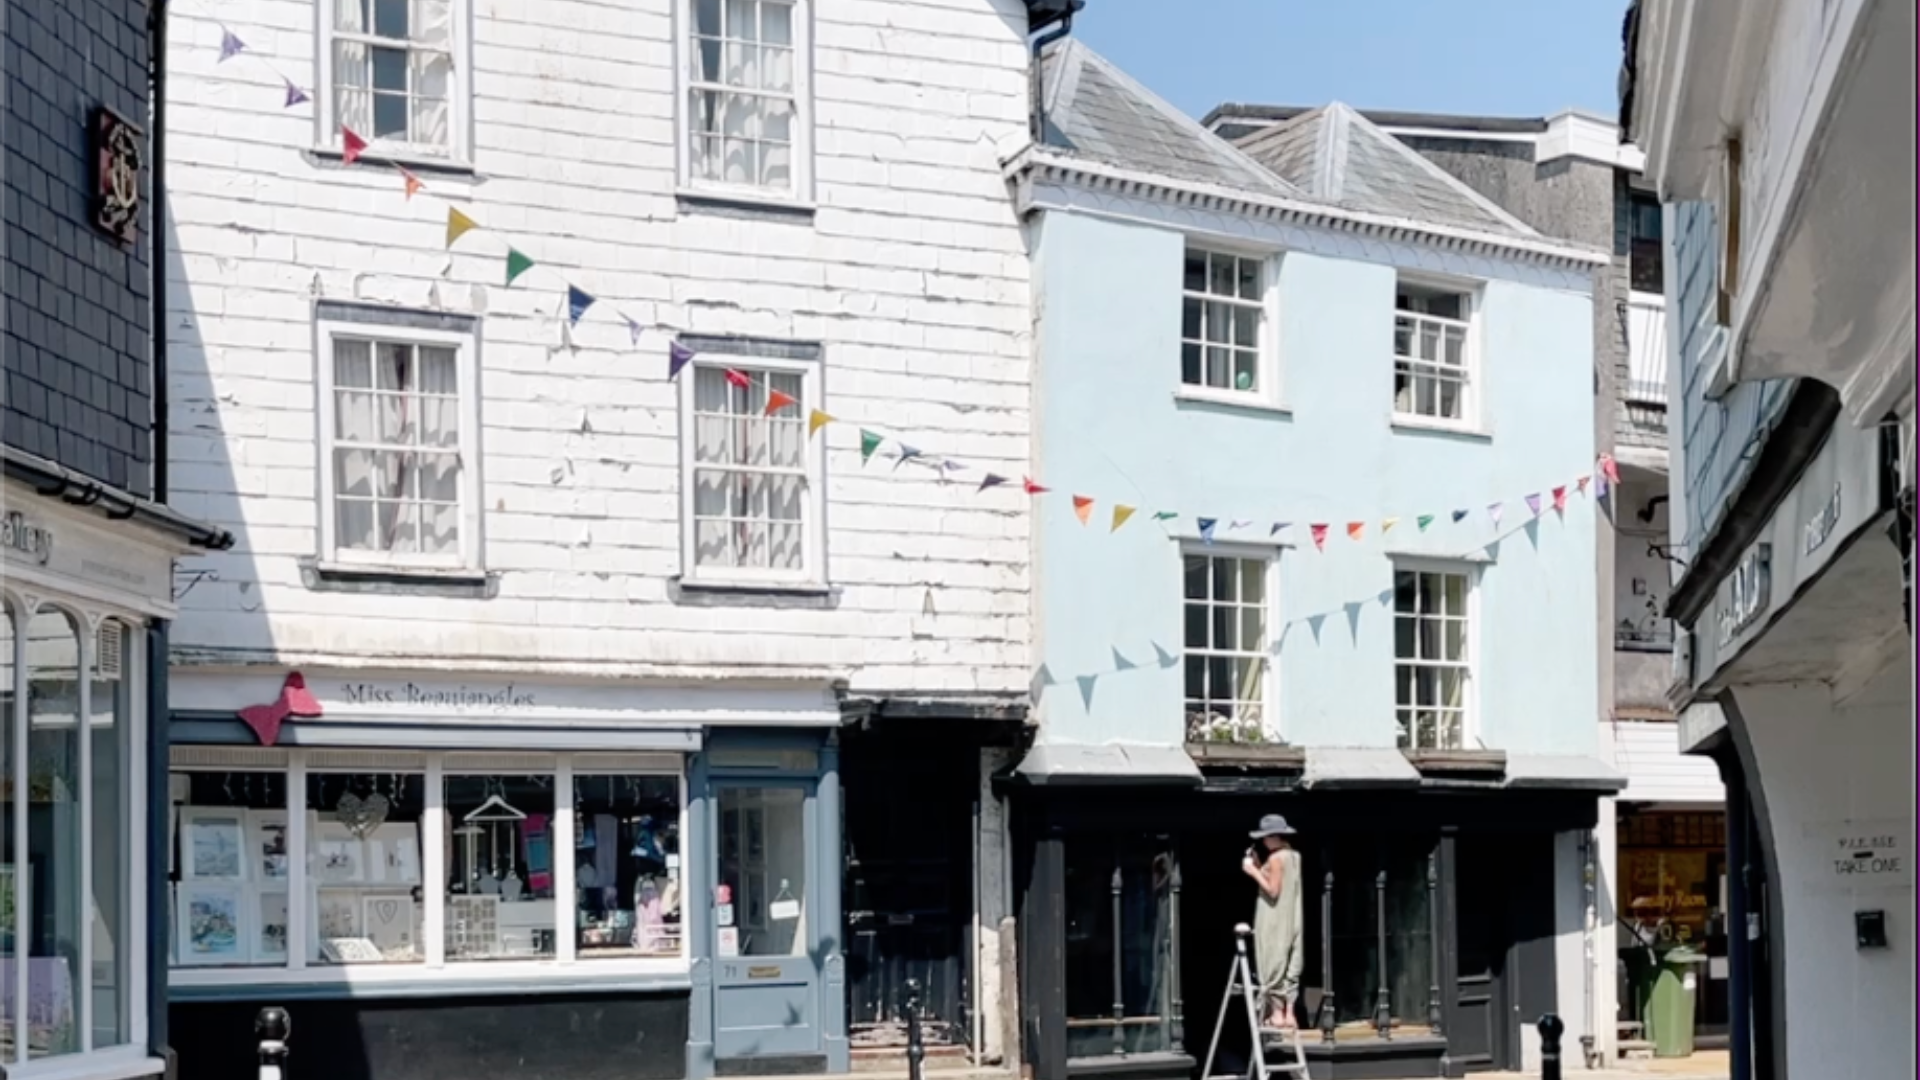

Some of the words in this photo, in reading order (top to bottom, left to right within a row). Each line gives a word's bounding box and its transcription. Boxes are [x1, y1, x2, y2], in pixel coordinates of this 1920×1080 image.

[342, 683, 394, 703] Miss
[1834, 859, 1868, 875] TAKE
[1871, 857, 1902, 873] ONE
[724, 965, 738, 978] 71
